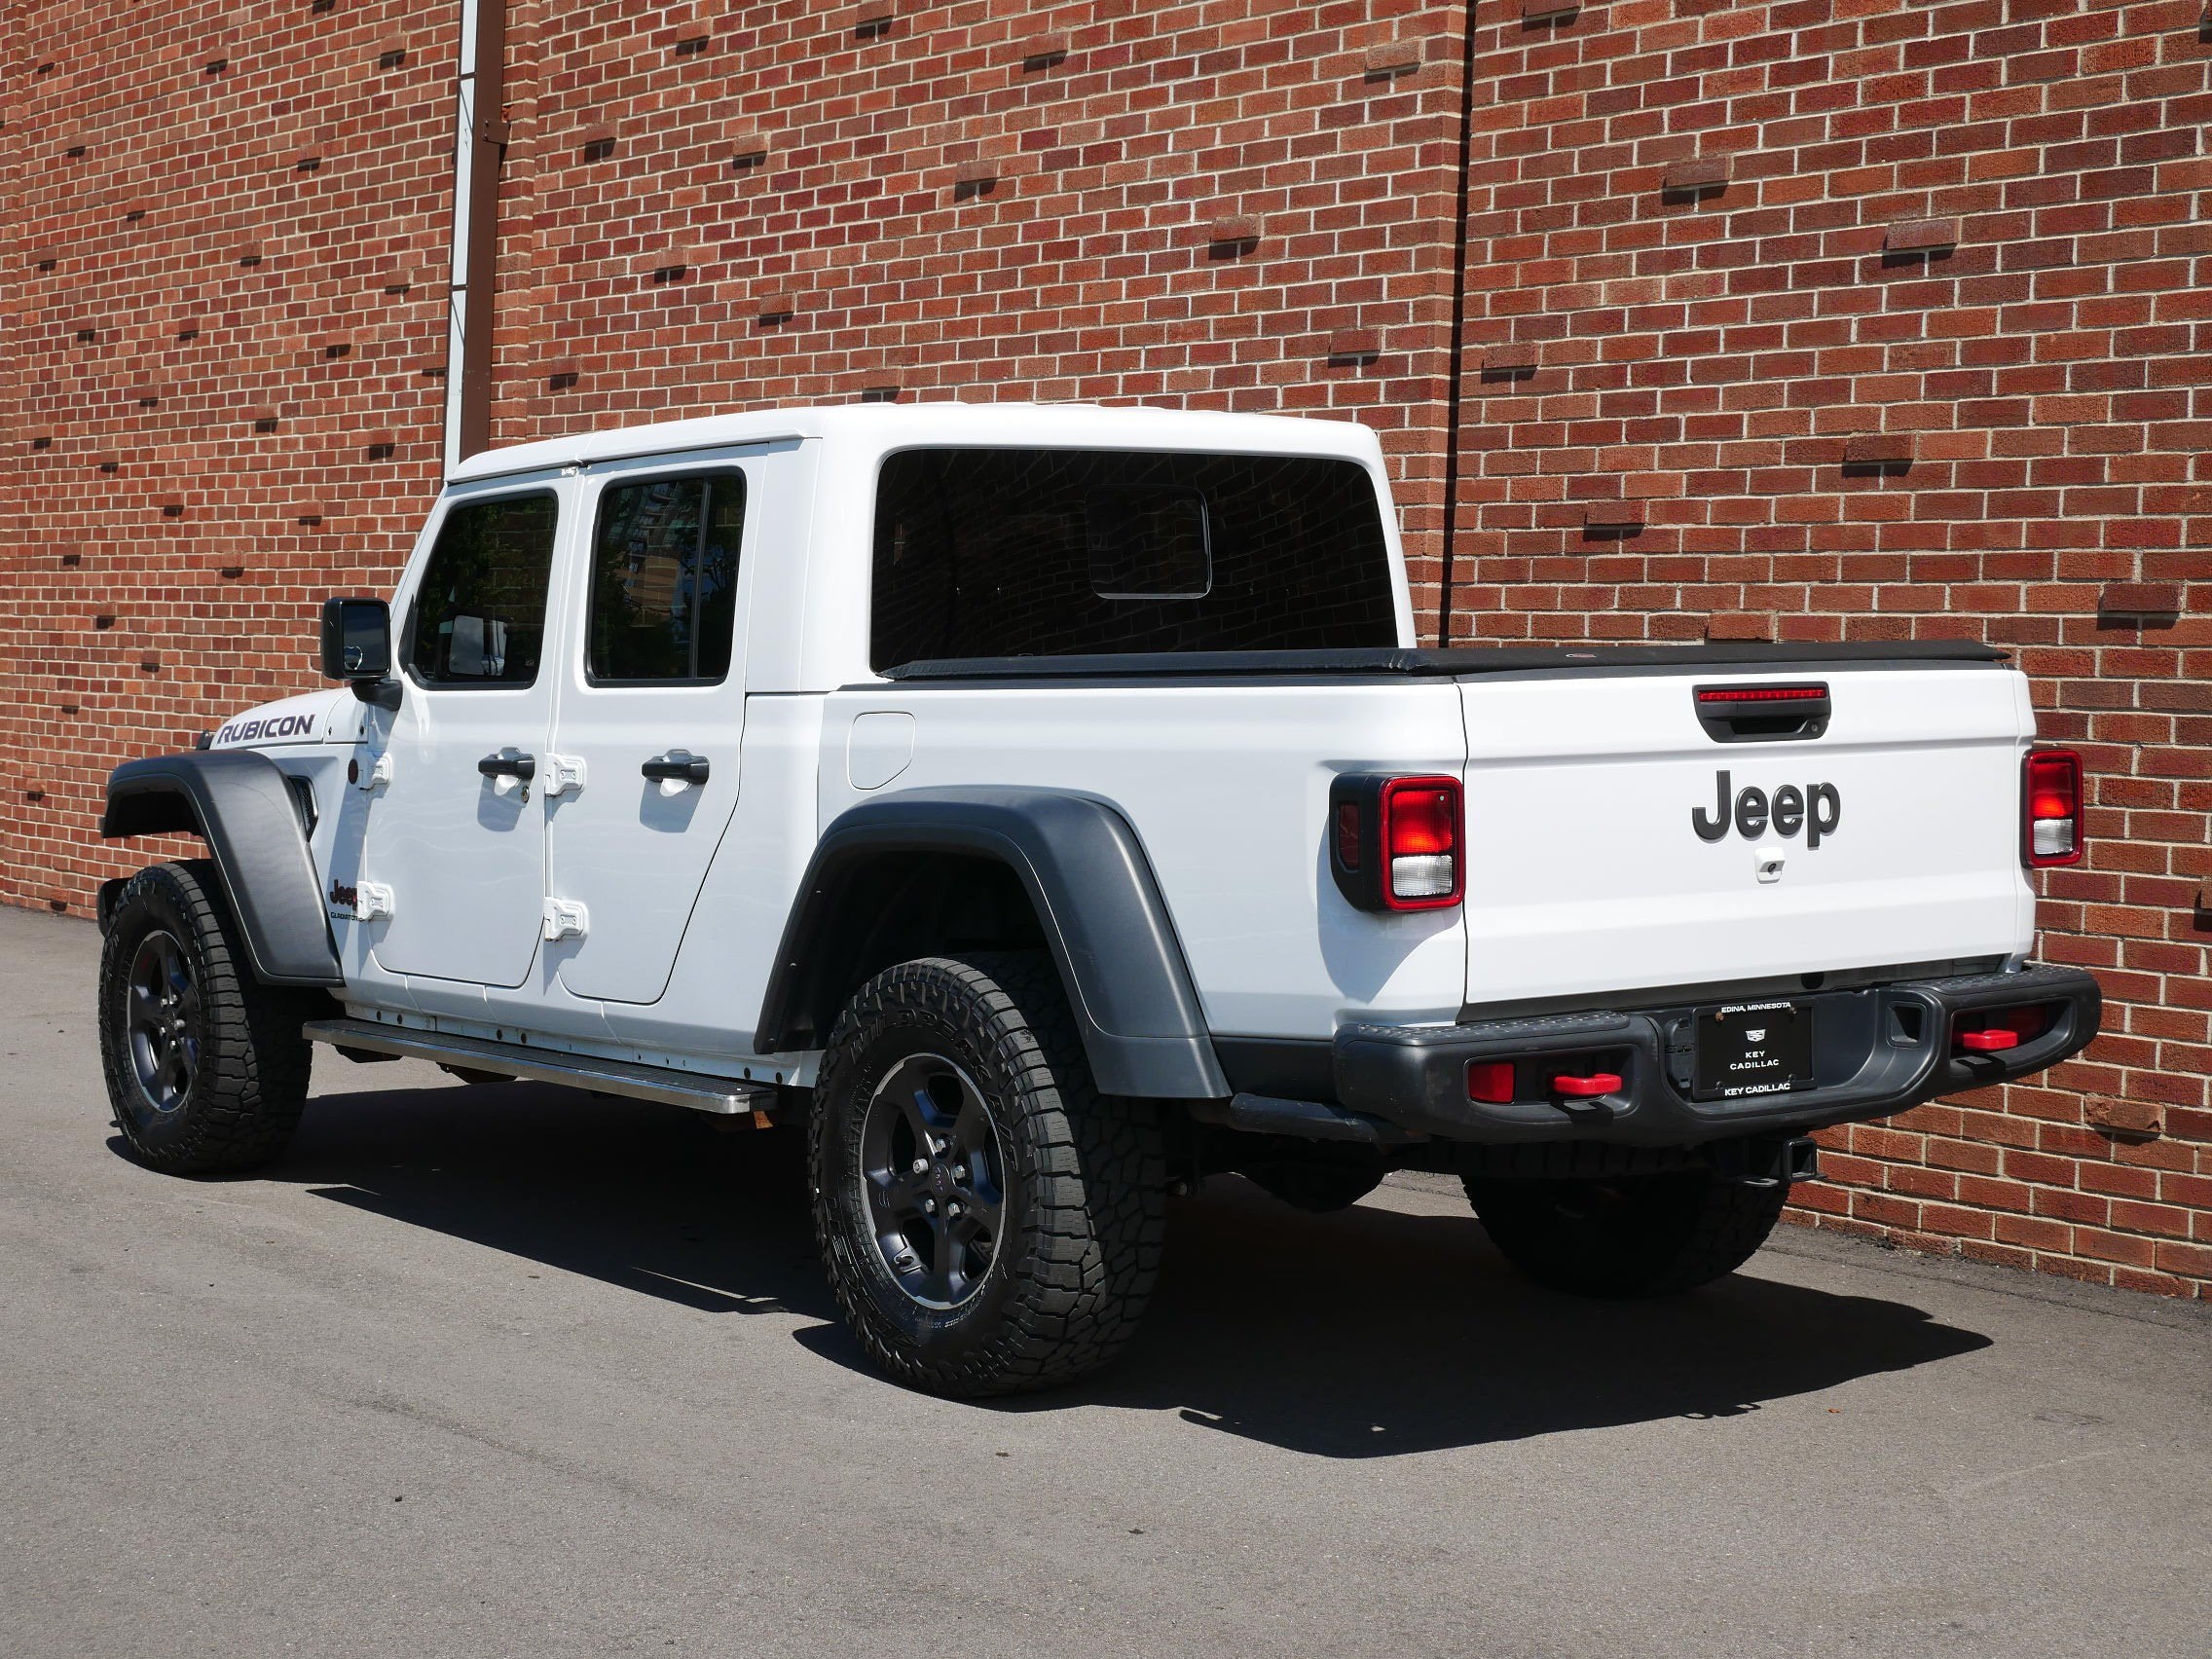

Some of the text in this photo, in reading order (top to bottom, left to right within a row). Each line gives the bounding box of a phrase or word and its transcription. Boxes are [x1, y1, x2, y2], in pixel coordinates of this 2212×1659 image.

[217, 714, 315, 744] RUBICON
[1692, 770, 1841, 848] Jeep
[1747, 1002, 1791, 1012] MINNESOTA
[1729, 1058, 1780, 1070] CADILLAC
[1724, 1083, 1791, 1096] KEY CADILLAC
